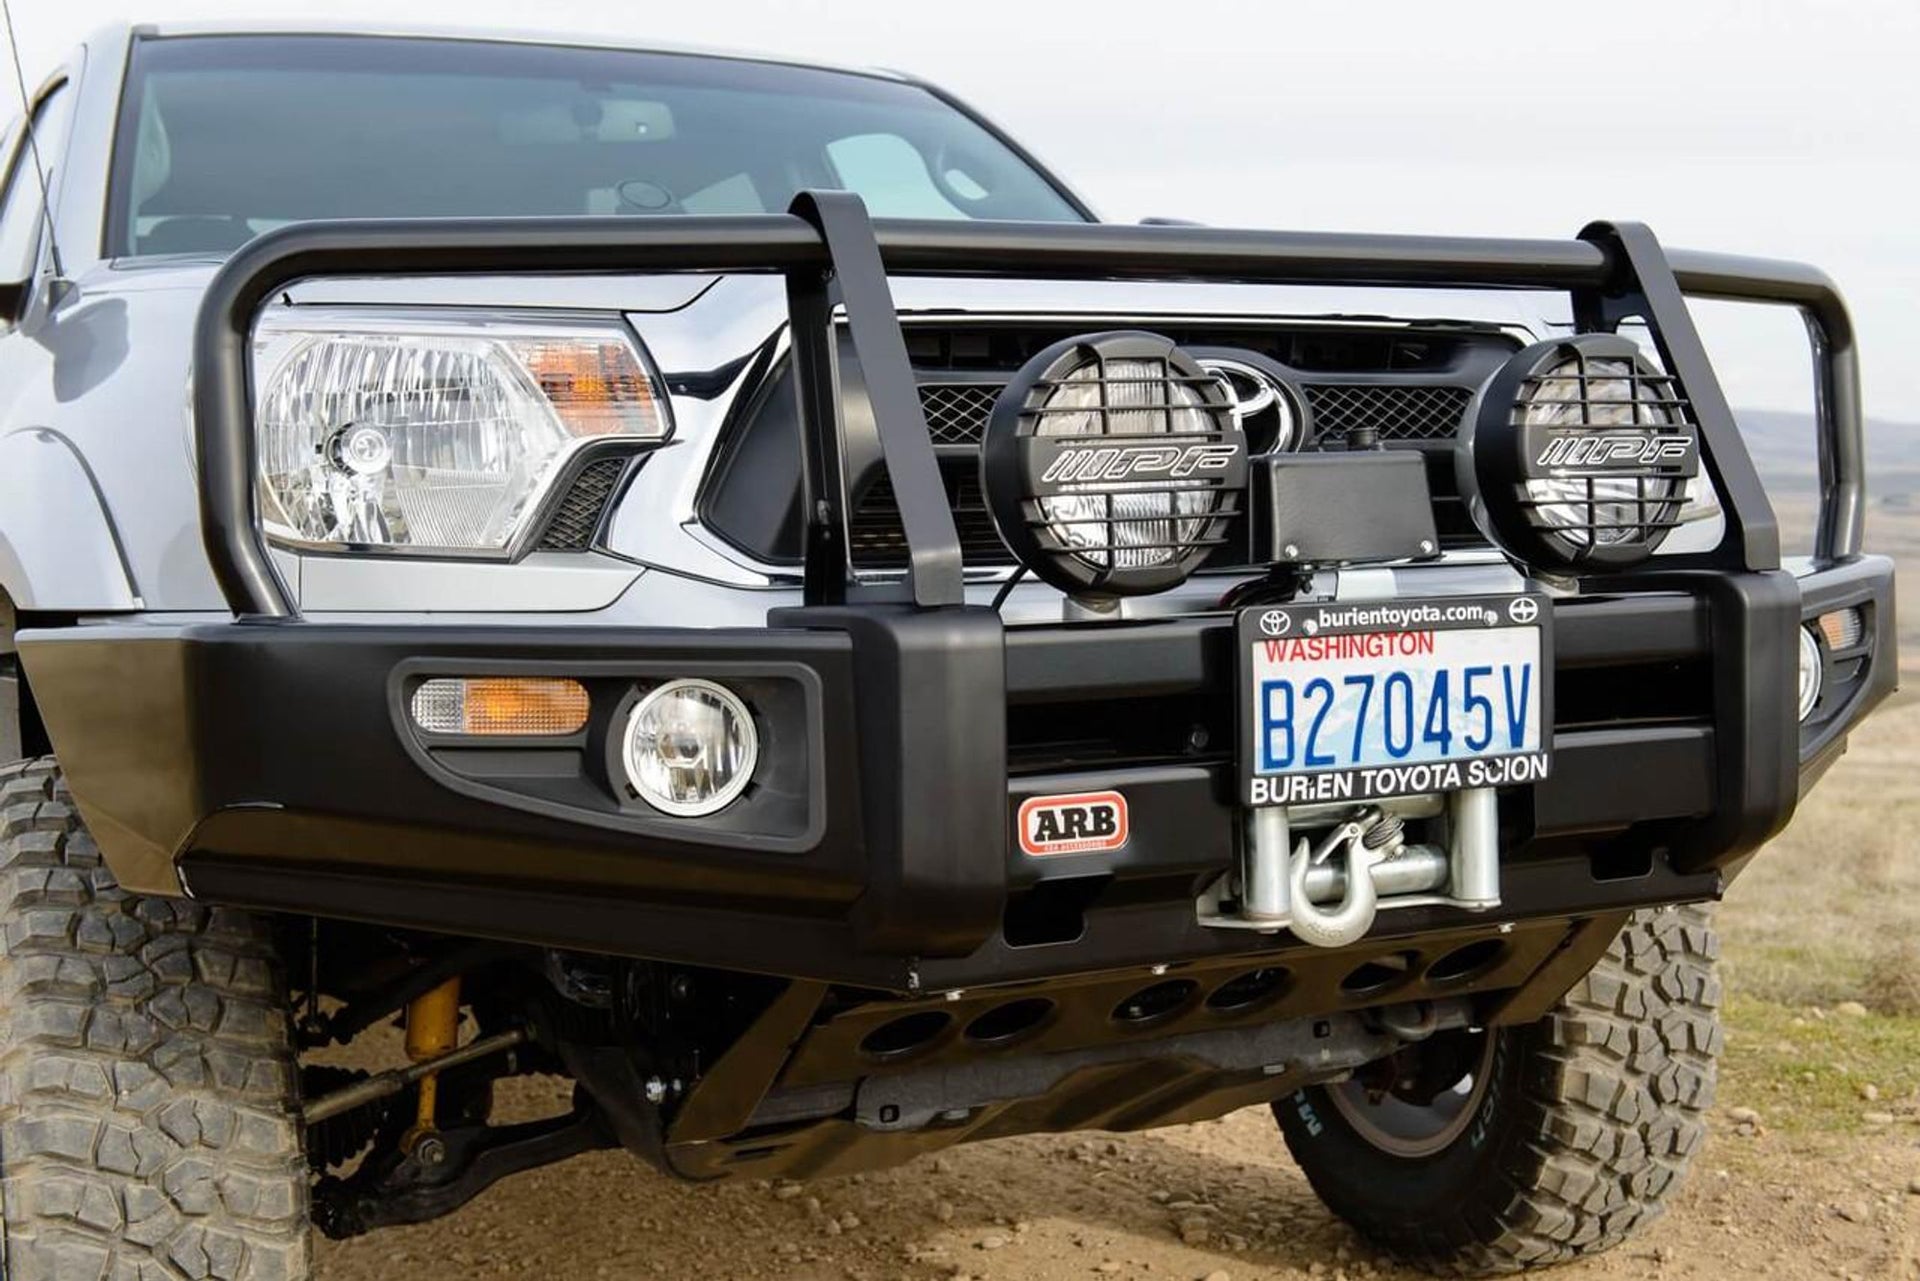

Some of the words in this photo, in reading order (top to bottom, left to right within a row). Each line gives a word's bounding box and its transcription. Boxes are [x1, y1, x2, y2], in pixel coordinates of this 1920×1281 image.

[1318, 604, 1484, 631] burientoyota.com
[1264, 629, 1435, 662] WASHINGTON
[1261, 663, 1531, 770] B27045V
[1360, 762, 1462, 796] TOYOTA
[1468, 753, 1549, 786] SCION
[1033, 805, 1117, 842] ARB
